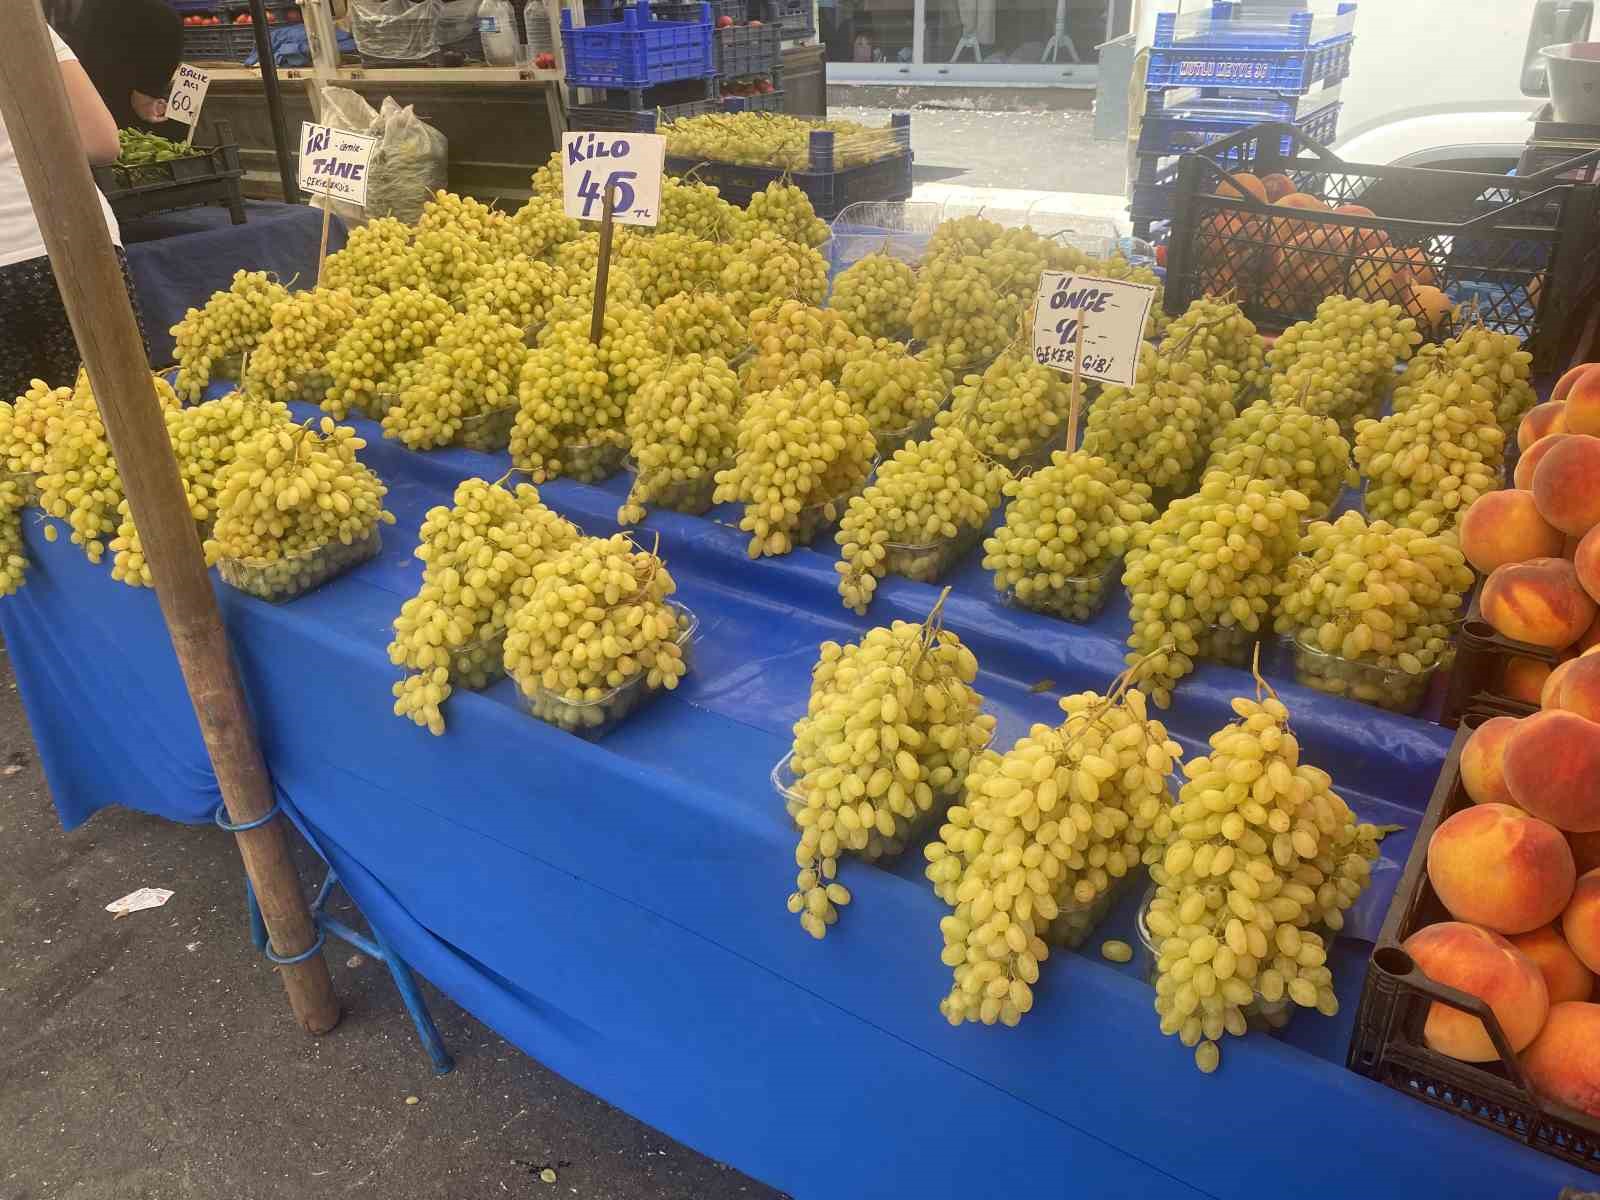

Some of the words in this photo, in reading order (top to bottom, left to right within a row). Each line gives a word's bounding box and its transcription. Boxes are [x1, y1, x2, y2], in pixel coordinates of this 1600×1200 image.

[179, 66, 208, 83] BALIK
[171, 90, 191, 111] 60
[312, 157, 365, 181] TANE
[577, 169, 638, 217] 45
[633, 208, 651, 217] TL
